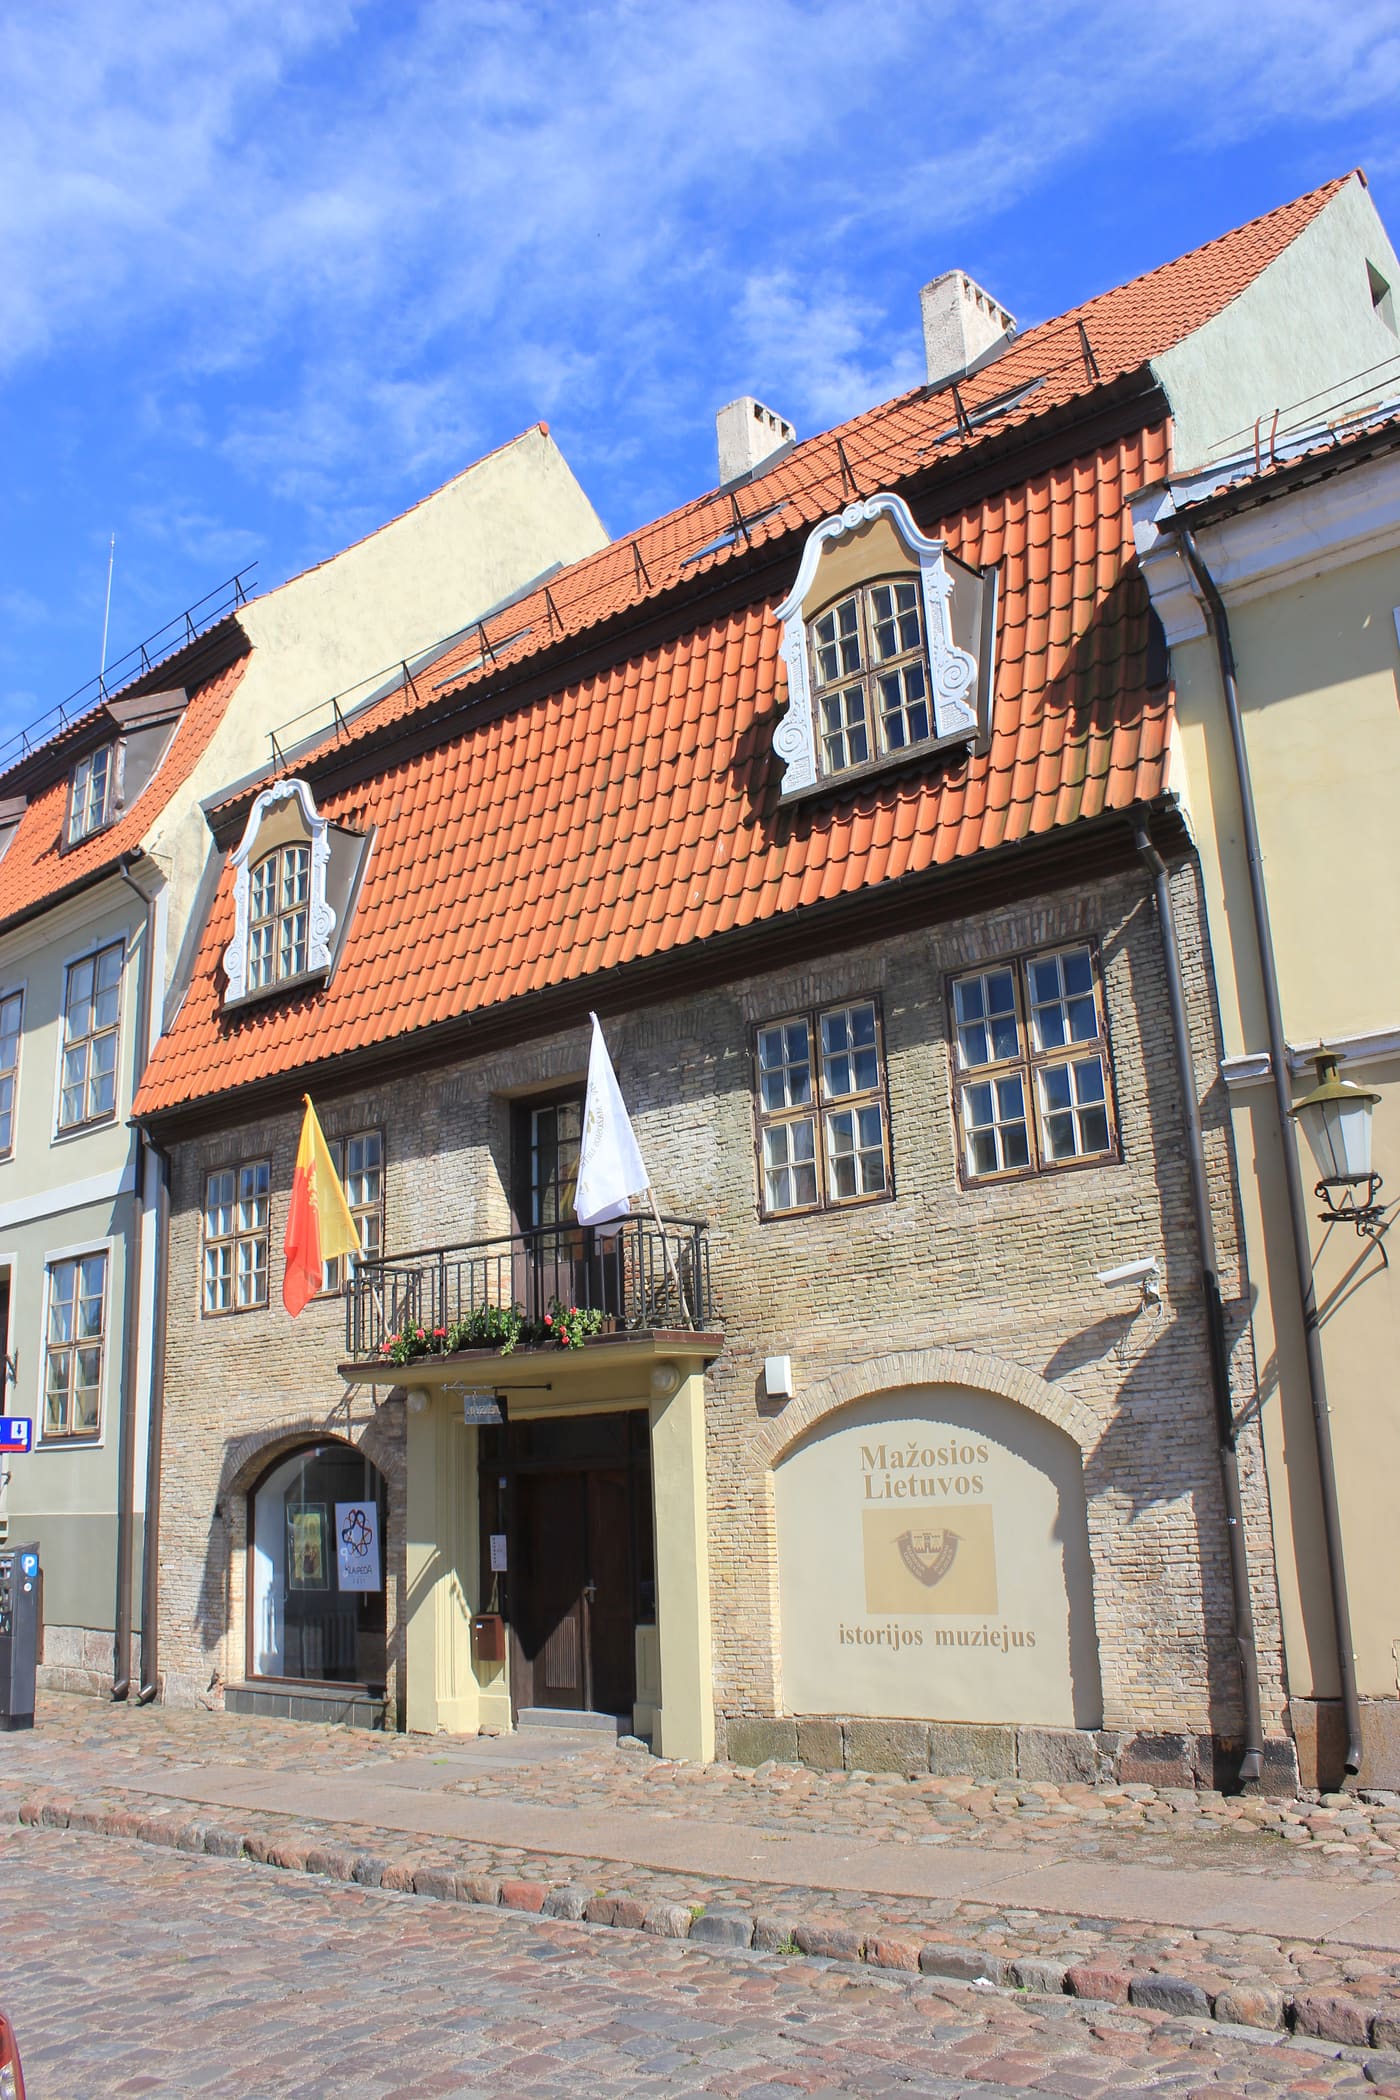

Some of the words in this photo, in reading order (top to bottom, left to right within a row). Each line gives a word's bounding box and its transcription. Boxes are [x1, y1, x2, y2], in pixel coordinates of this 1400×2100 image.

[860, 1440, 989, 1471] Mažosios
[864, 1473, 984, 1499] Lietuvos
[24, 1556, 35, 1574] P
[839, 1624, 924, 1651] istorijos
[935, 1625, 1036, 1653] muziejus
